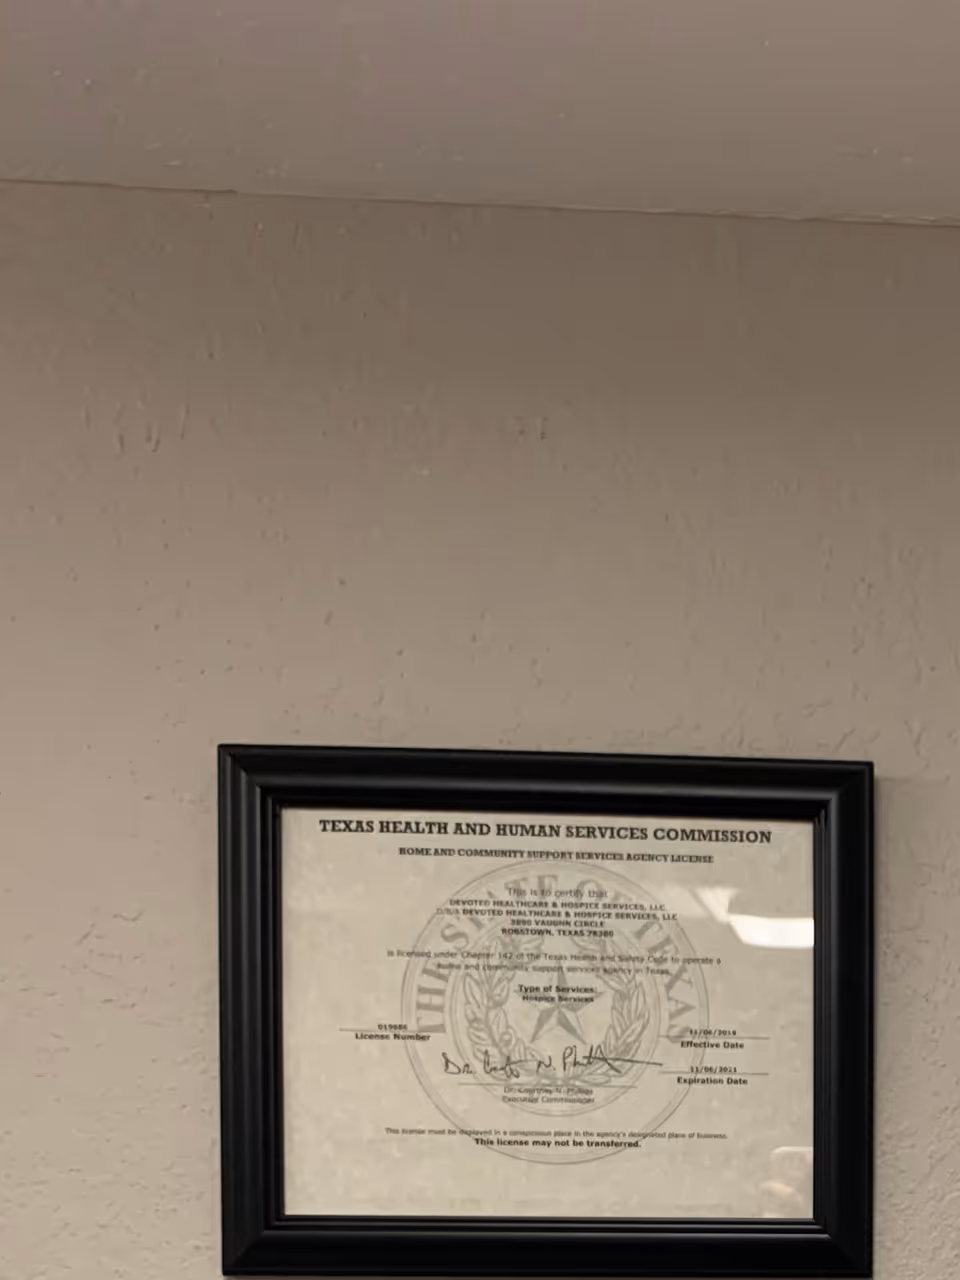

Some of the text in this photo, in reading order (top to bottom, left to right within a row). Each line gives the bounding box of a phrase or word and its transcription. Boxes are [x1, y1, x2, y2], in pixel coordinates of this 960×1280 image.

[319, 819, 771, 843] TEXAS HEALTH AND HUMAN SERVICES COMMISSION
[398, 847, 713, 863] HOME AND COMMUNITY SUPPORT SERVICES AGENCY LICENSE
[355, 1032, 430, 1041] License Number
[676, 1076, 724, 1086] Expiration
[474, 1138, 495, 1147] This
[496, 1138, 529, 1146] license
[586, 1140, 641, 1148] transferred.
